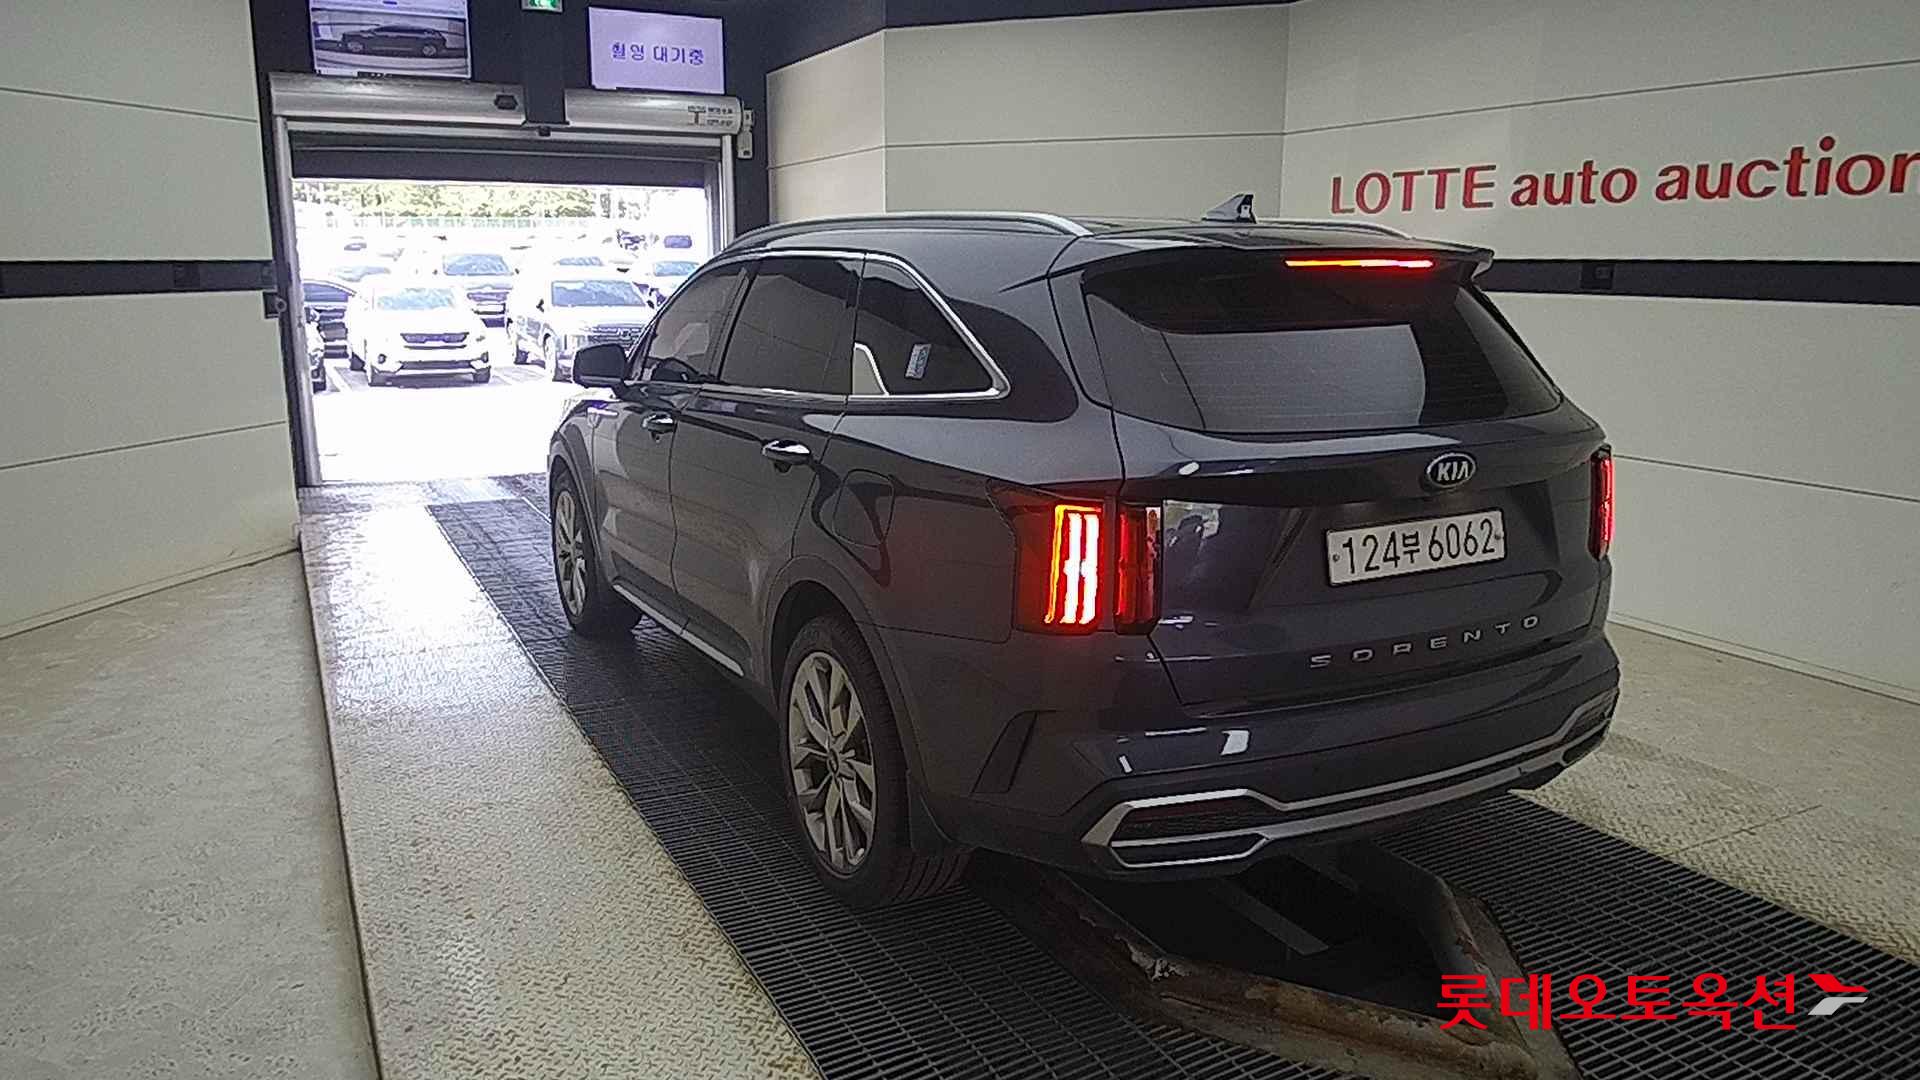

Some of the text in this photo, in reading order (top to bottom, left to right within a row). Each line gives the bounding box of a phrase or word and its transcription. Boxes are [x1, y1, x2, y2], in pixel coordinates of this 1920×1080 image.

[653, 46, 704, 65] 대기중
[1331, 164, 1497, 215] LOTTE
[1511, 160, 1638, 207] auto
[1437, 461, 1469, 481] KIA
[1309, 615, 1539, 669] SORENTO
